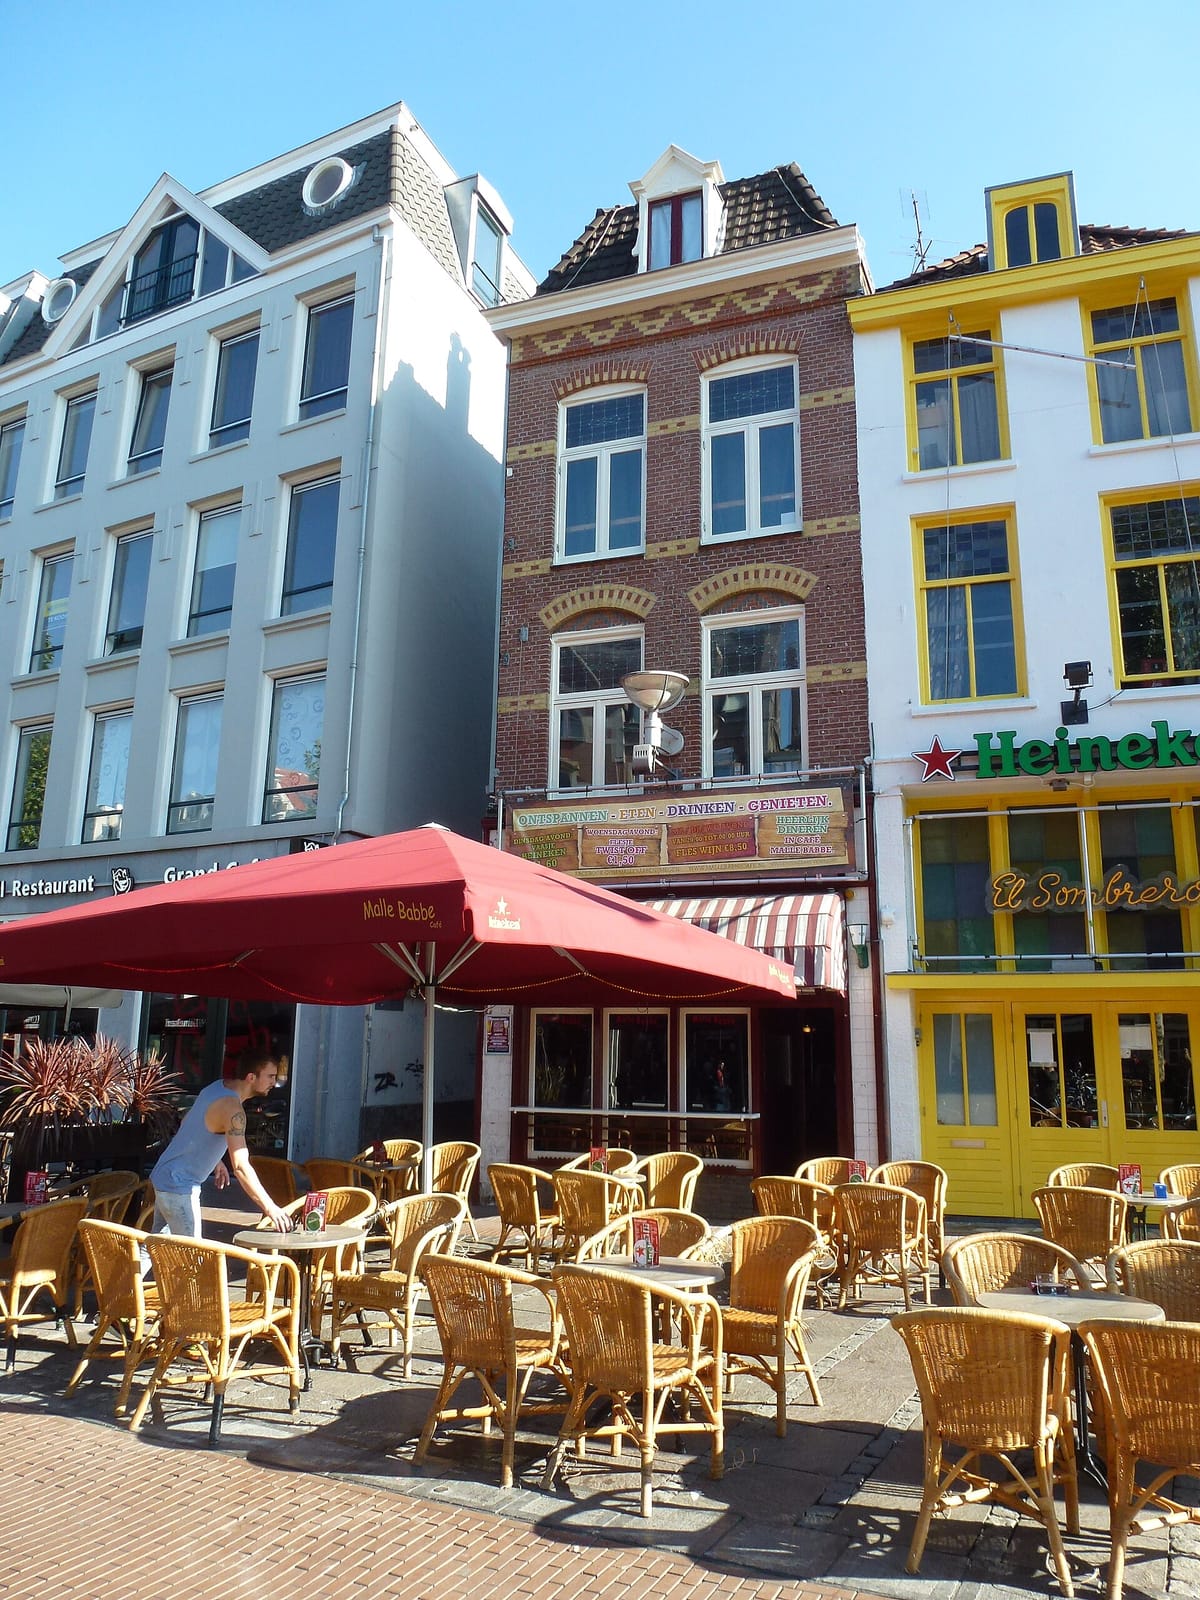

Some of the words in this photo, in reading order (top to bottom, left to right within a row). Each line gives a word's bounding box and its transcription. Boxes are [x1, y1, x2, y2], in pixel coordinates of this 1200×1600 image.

[973, 719, 1200, 779] Heinek
[518, 810, 608, 826] ONTSPANNEN
[619, 807, 656, 820] ETEN
[667, 801, 735, 817] DRINKEN
[747, 794, 832, 812] GENIETEN.
[777, 816, 829, 825] HEERLIJK
[778, 825, 827, 834] DINEREN
[513, 836, 544, 845] DINSDAG
[546, 832, 571, 841] AVOND
[522, 848, 567, 859] HEINEKEN
[627, 846, 647, 854] OFF
[677, 847, 698, 857] FLES
[700, 844, 722, 855] WIJN
[803, 846, 832, 854] BABBE
[607, 856, 634, 866] €1,50
[12, 875, 95, 897] Restaurant
[992, 872, 1025, 908] El
[363, 898, 395, 920] Malle
[398, 901, 435, 921] Babbe
[429, 921, 442, 929] Café
